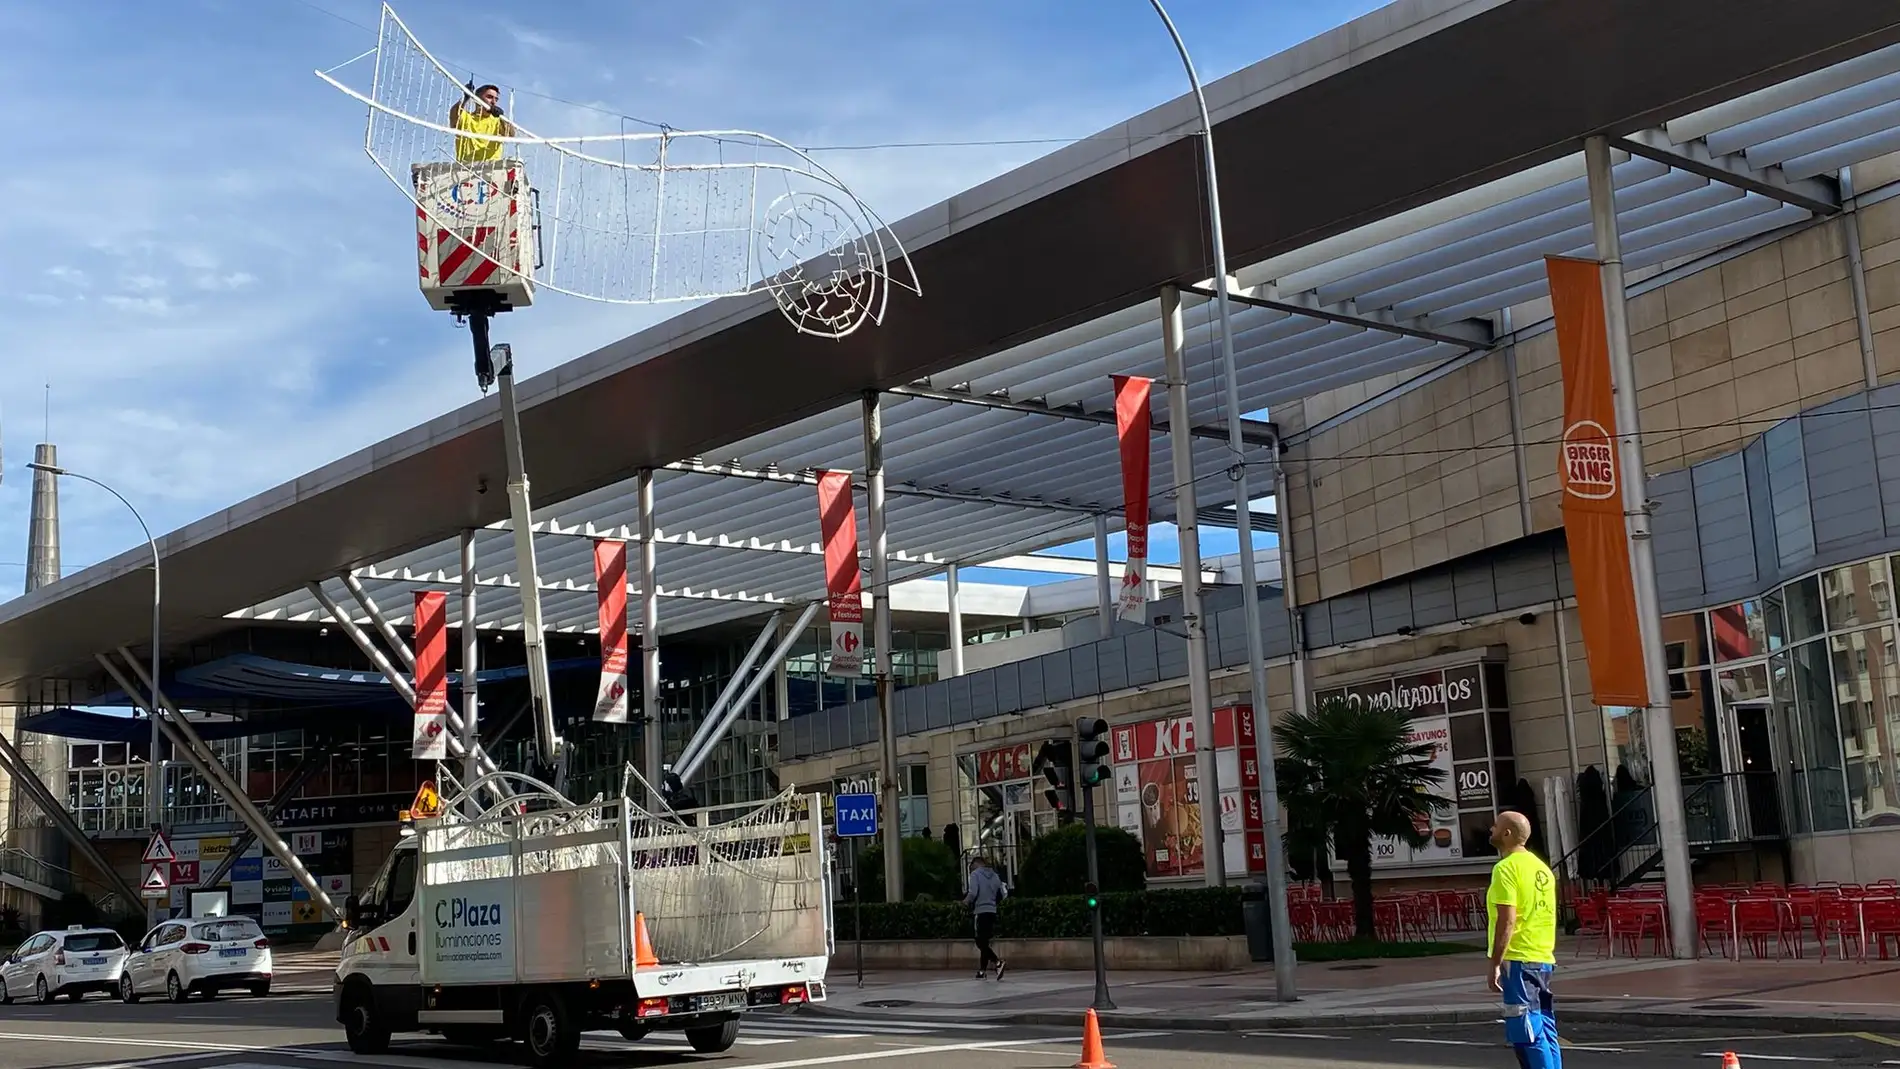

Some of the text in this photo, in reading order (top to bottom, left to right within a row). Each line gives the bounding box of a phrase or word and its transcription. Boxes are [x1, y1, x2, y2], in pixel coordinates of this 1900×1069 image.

[1567, 446, 1611, 461] BRGER
[1243, 711, 1252, 737] KFC
[979, 744, 1030, 783] KFC
[1459, 769, 1490, 790] 100
[276, 806, 337, 820] LTAFIT
[839, 808, 874, 821] TAXI
[1250, 794, 1259, 821] KFC
[203, 844, 231, 854] Hertz
[435, 897, 501, 929] C.Plaza
[703, 994, 726, 1007] 9937
